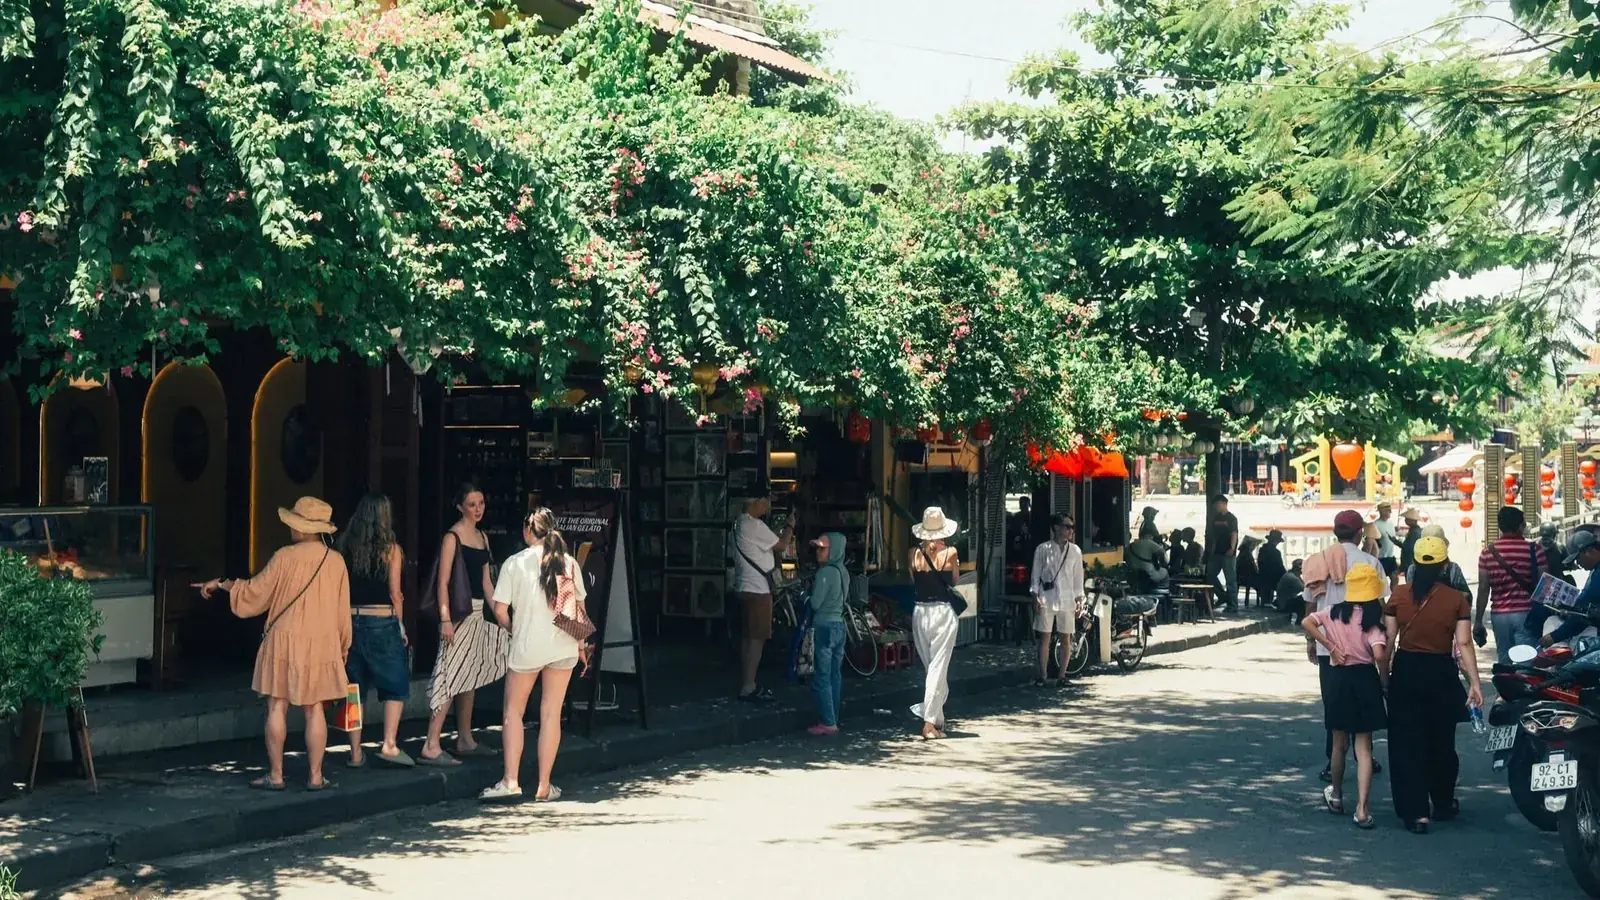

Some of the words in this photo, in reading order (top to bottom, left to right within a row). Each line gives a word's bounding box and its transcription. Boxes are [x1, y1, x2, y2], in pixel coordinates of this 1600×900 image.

[567, 517, 579, 525] THE
[580, 517, 609, 526] ORIGINAL
[577, 524, 602, 532] GELATO
[1539, 763, 1569, 776] 92-C1
[1533, 775, 1574, 789] 249.36
